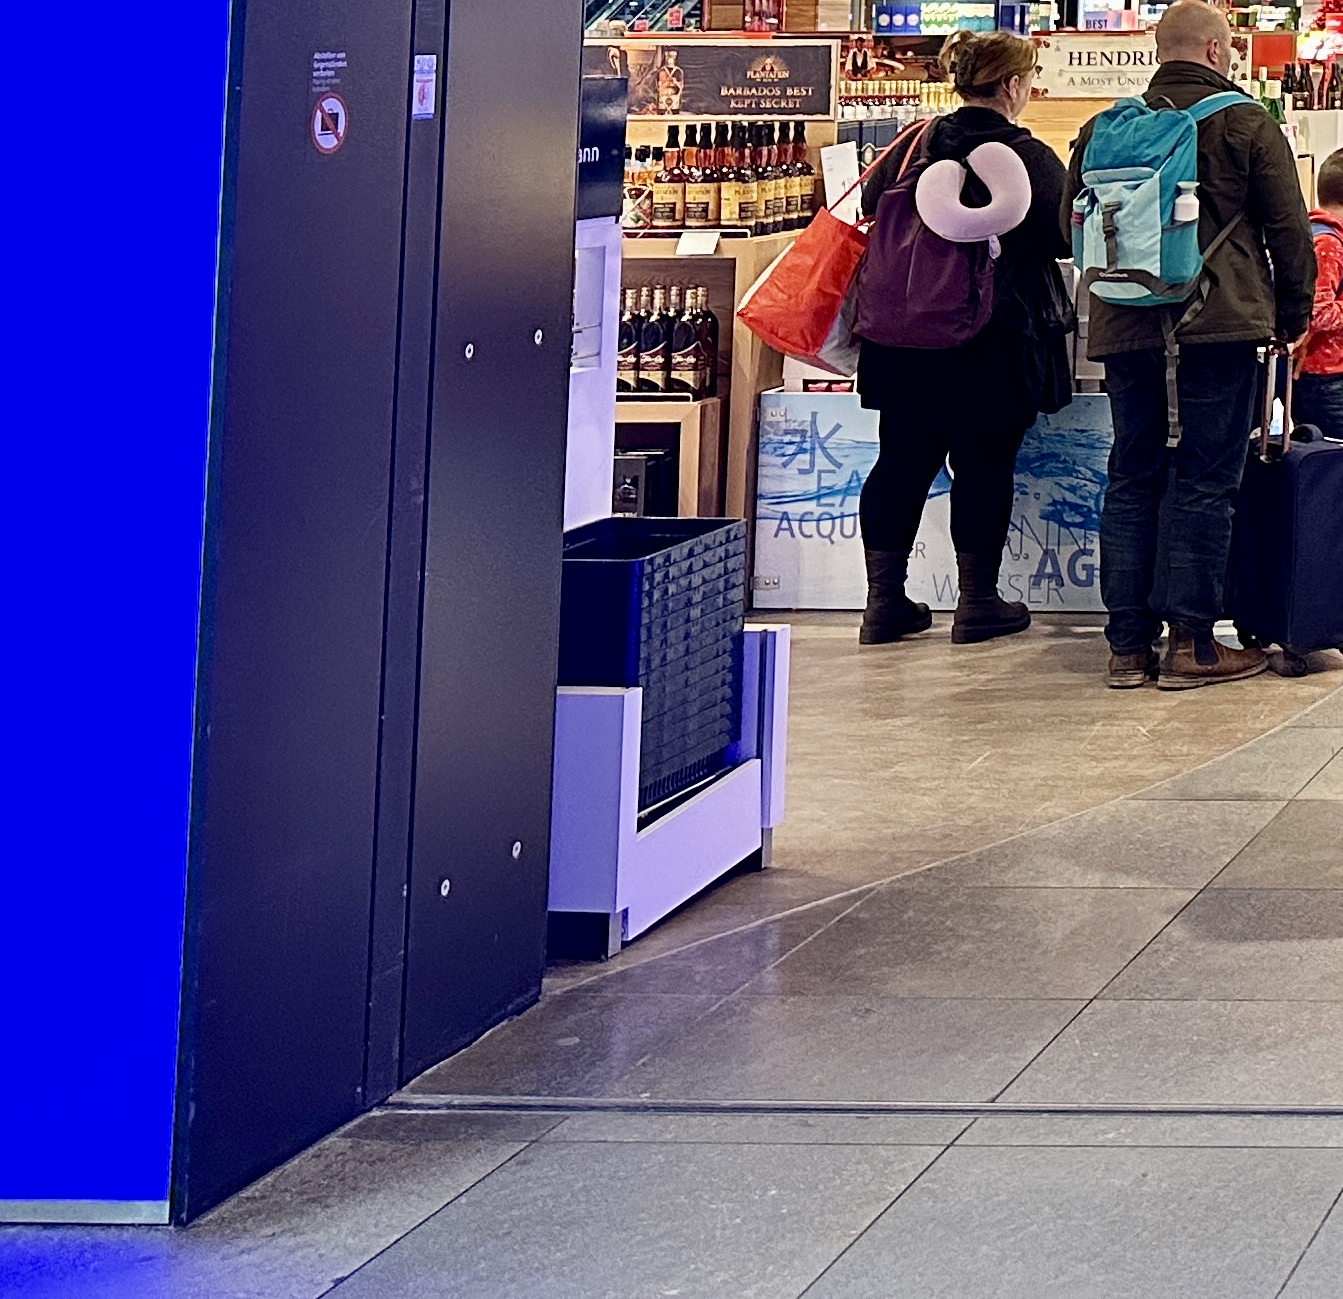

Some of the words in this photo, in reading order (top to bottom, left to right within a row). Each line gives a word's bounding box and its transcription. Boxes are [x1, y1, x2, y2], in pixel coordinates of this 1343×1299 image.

[720, 86, 781, 96] BARBADOS
[786, 86, 814, 96] BEST
[1067, 76, 1076, 86] A
[1117, 75, 1151, 86] UNUS
[730, 98, 758, 108] KEPT
[760, 98, 802, 108] SECRET
[781, 411, 844, 475] 水
[815, 469, 863, 508] EA
[773, 511, 863, 545] ACQU
[1031, 548, 1095, 588] AG
